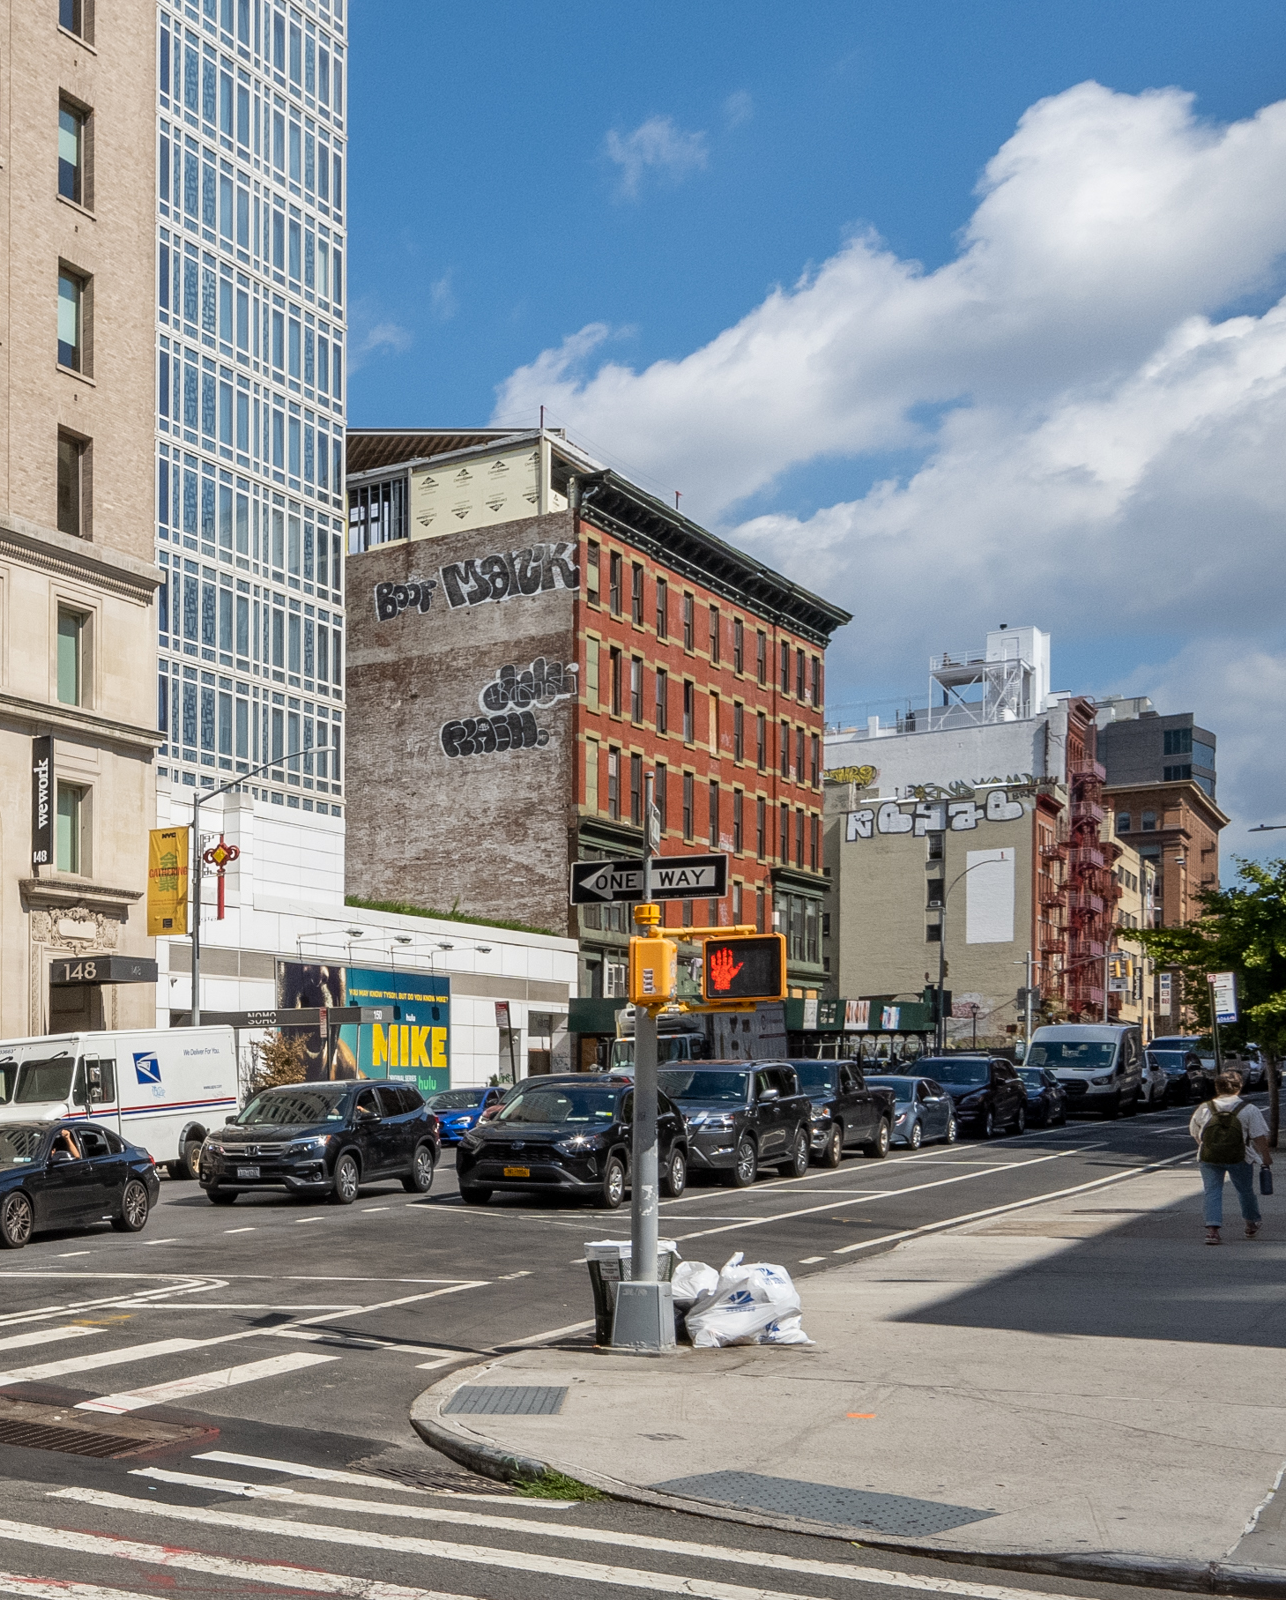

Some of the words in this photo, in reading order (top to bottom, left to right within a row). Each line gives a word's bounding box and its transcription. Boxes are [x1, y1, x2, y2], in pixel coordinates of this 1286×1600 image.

[34, 758, 49, 829] wework
[33, 850, 47, 862] 148
[149, 866, 187, 878] GATHERING
[595, 872, 637, 890] ONE
[659, 869, 705, 886] WAY
[64, 962, 97, 980] 148
[373, 1010, 382, 1020] 150
[405, 1013, 415, 1022] hulu
[373, 1023, 447, 1068] MIKE
[418, 1076, 437, 1091] hulu
